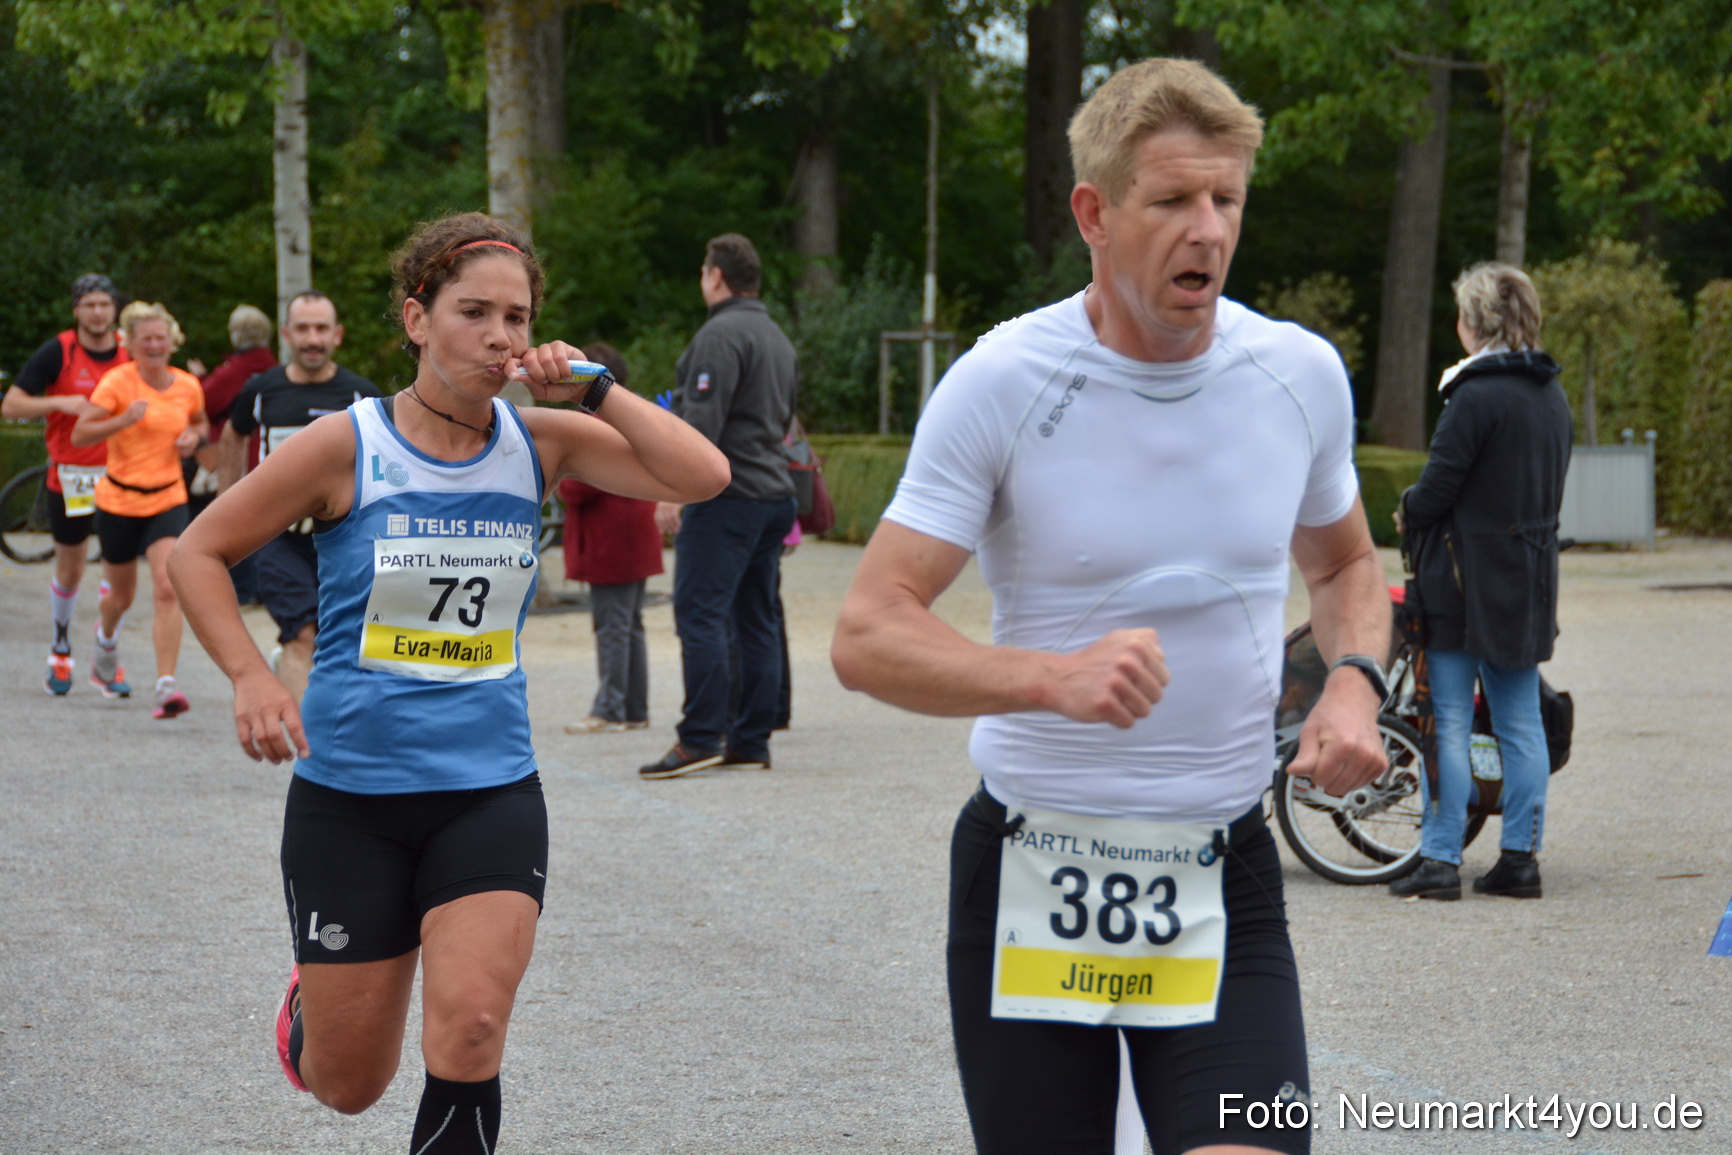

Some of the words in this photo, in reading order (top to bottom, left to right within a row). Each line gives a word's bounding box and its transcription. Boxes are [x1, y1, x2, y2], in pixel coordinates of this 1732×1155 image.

[371, 454, 410, 488] LG
[415, 518, 467, 536] TELIS
[474, 520, 533, 539] FINANZ
[380, 554, 435, 568] PARTL
[440, 554, 513, 568] Neumarkt
[372, 613, 380, 622] A
[428, 576, 490, 628] 73
[393, 635, 492, 662] Eva-Maria
[1010, 829, 1084, 855] PARTL
[1091, 839, 1191, 863] Neumarkt
[1050, 866, 1182, 945] 383
[308, 911, 349, 950] LG
[1061, 963, 1153, 1003] Jürgen
